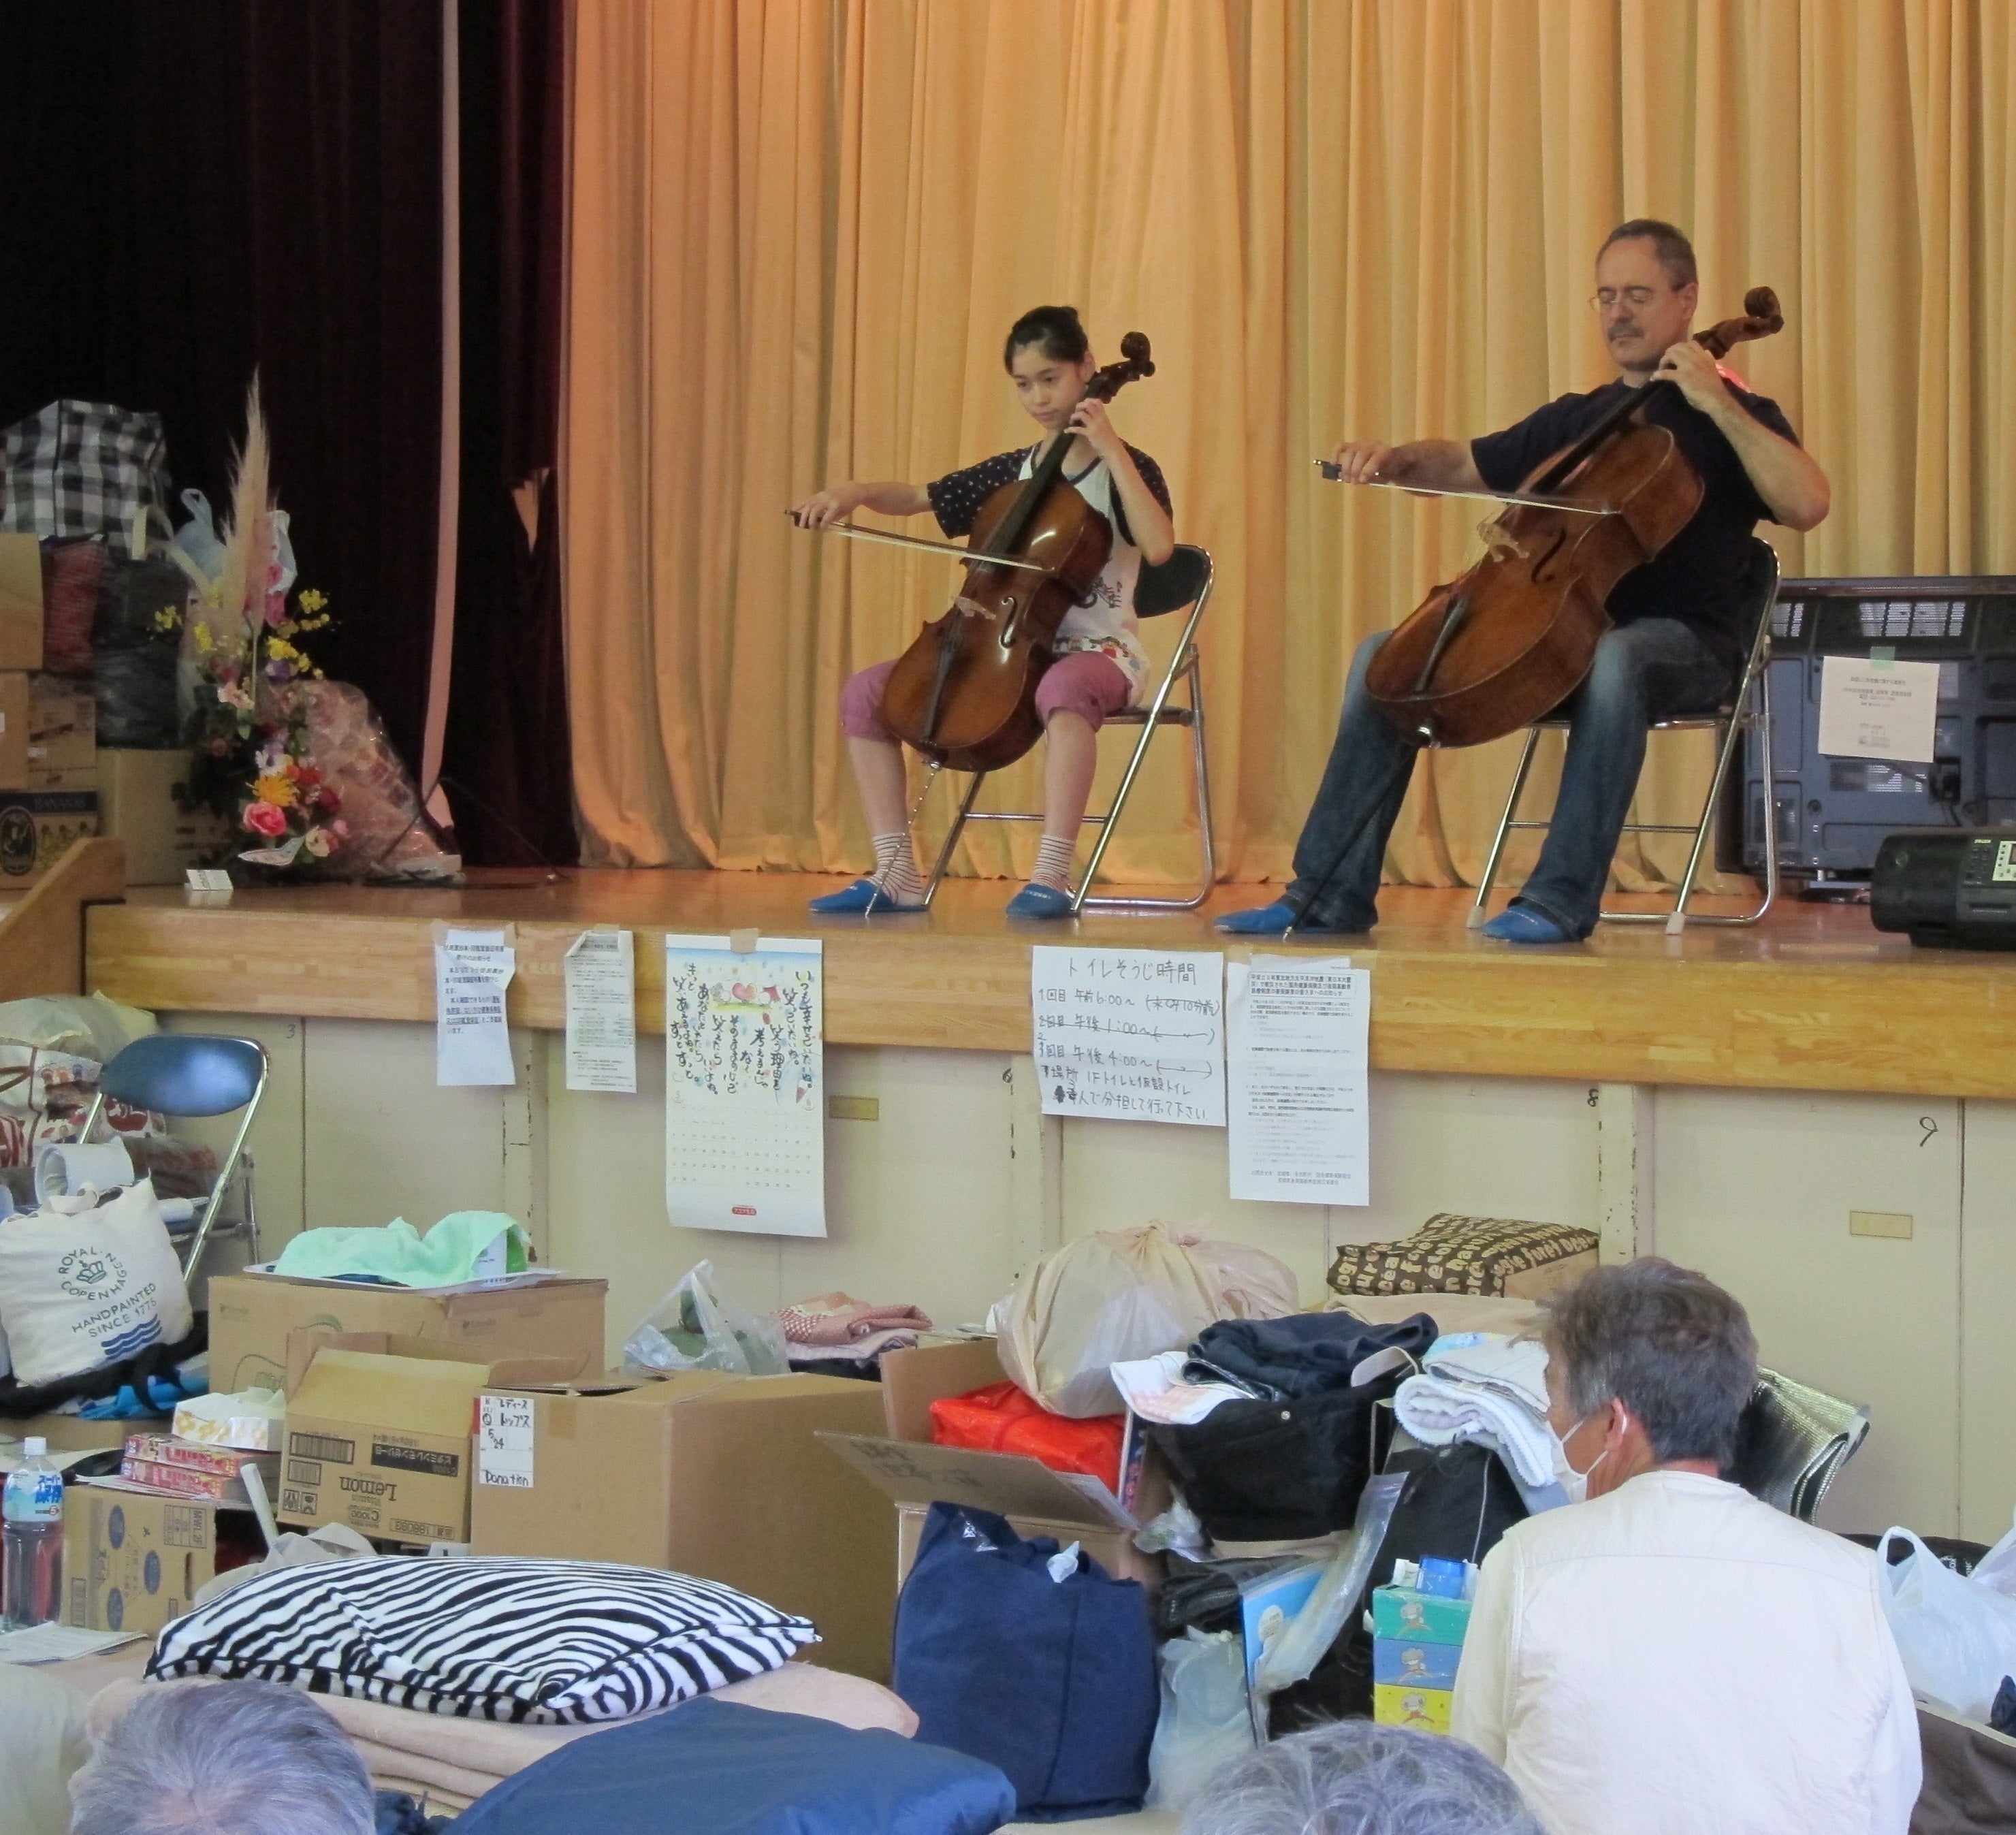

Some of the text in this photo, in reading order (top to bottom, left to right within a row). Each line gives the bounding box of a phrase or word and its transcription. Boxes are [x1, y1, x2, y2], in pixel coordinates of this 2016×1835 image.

[1068, 958, 1196, 985] トイレそうじ時間
[1587, 1088, 1599, 1107] 8
[1919, 1117, 1939, 1147] 9
[59, 1246, 98, 1275] ROYAL
[61, 1252, 128, 1301] COPENHAGEN
[71, 1283, 157, 1333] HANDPAINTED
[88, 1297, 157, 1338] SINCE 1775
[339, 1476, 398, 1502] Lemon
